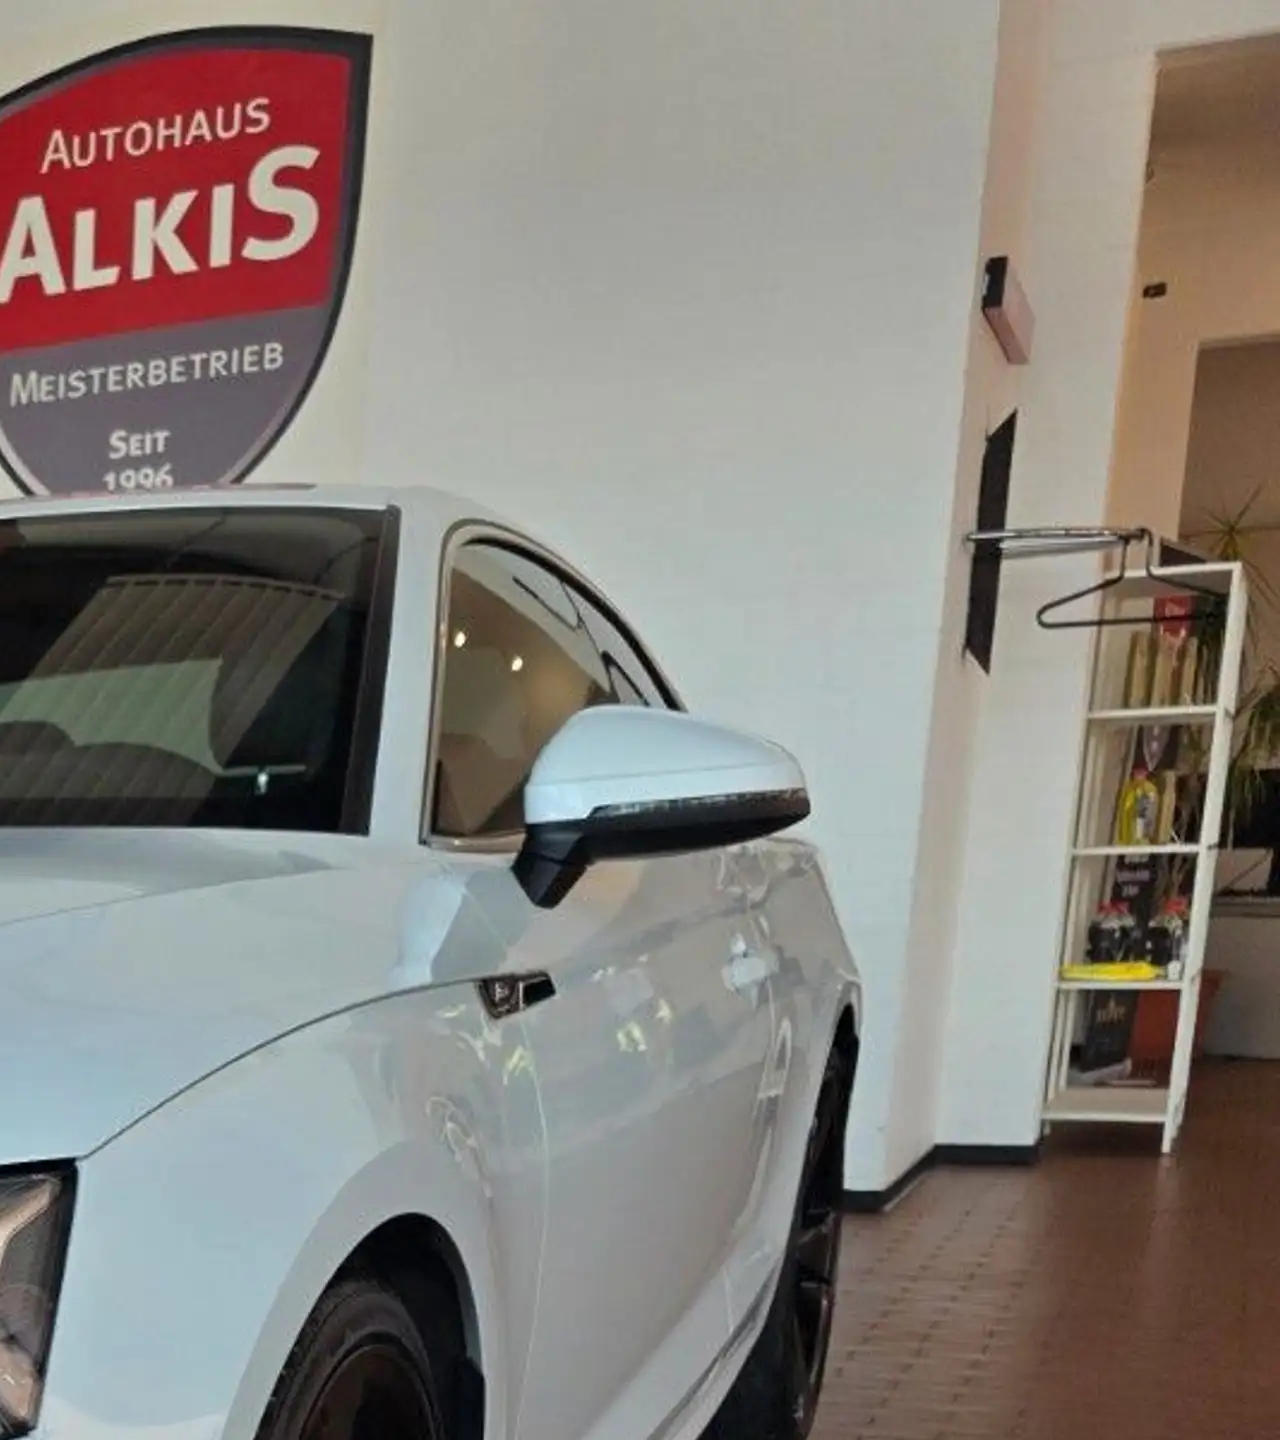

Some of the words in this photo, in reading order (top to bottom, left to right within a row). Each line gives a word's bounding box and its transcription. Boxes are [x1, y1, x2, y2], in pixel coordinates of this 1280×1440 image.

[40, 97, 270, 173] AUTOHAUS
[10, 343, 283, 406] MEISTERBETRIEB
[108, 430, 170, 459] SEIT
[103, 463, 173, 490] 1996
